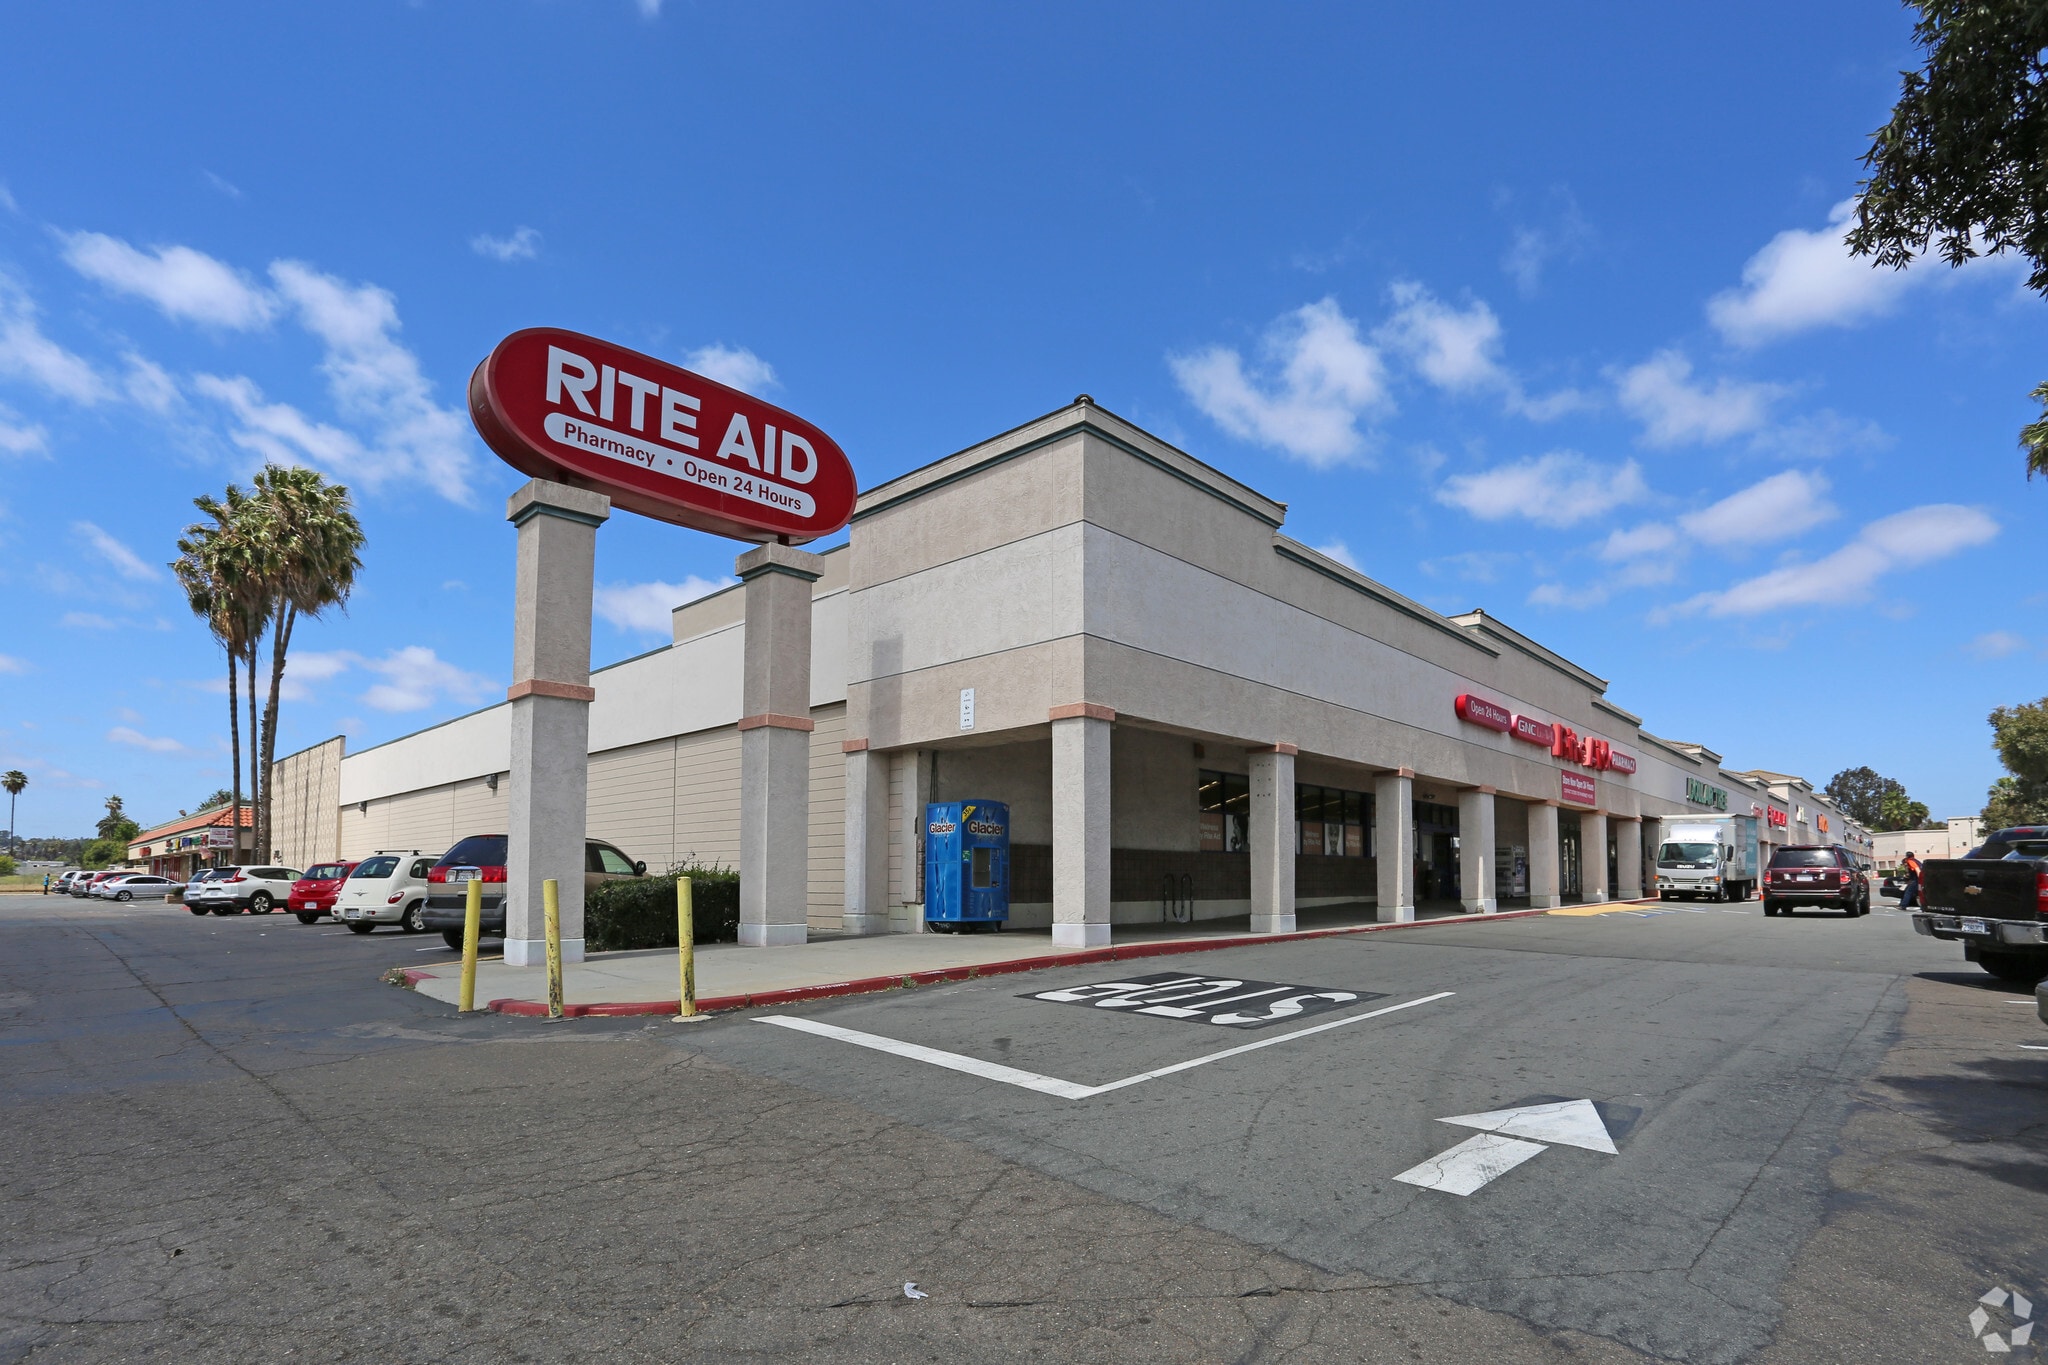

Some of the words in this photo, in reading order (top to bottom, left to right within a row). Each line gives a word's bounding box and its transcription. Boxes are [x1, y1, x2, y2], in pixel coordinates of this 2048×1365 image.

[546, 344, 701, 450] RITE
[716, 412, 818, 485] AID
[564, 421, 655, 467] Pharmacy
[684, 460, 727, 488] Open
[733, 476, 753, 495] 24
[758, 483, 802, 511] Hours
[1470, 700, 1485, 716] Open
[1485, 706, 1492, 719] 24
[1492, 708, 1507, 724] Hours
[1518, 719, 1537, 736] GNC
[1611, 751, 1635, 771] PHARMACY
[929, 823, 956, 834] Glacier
[968, 820, 1004, 836] Glacier
[1035, 977, 1358, 1025] STOP
